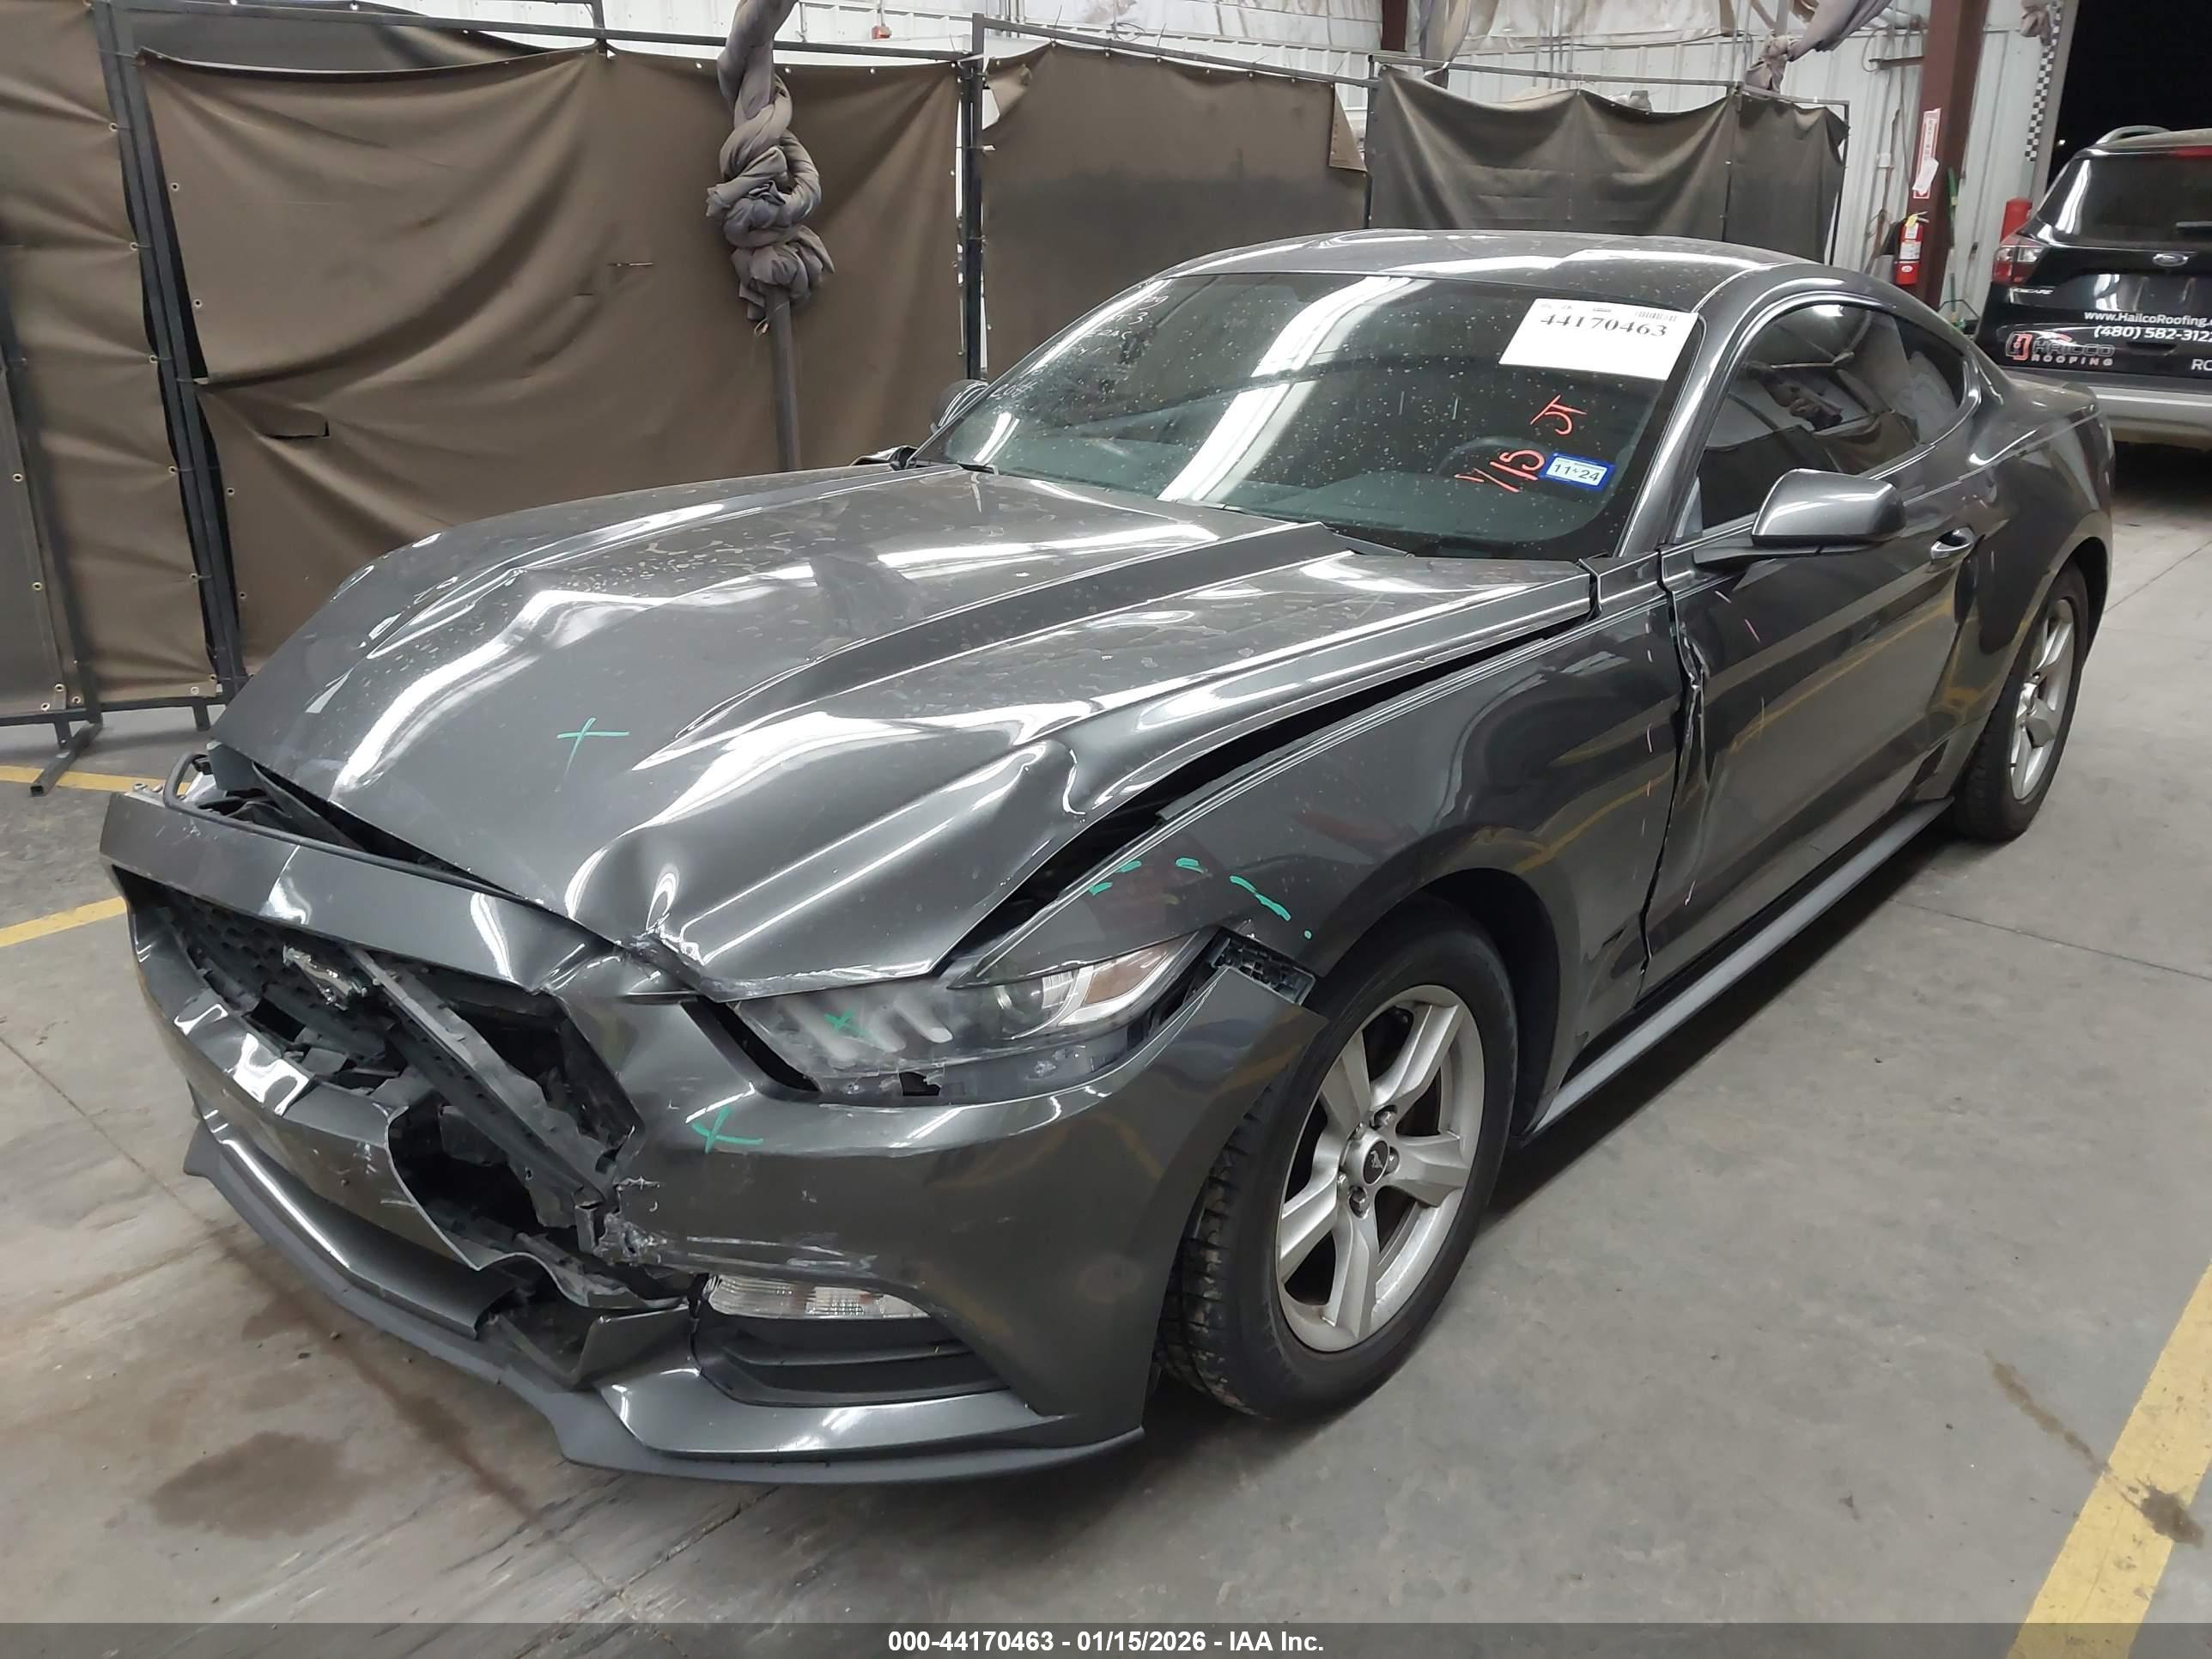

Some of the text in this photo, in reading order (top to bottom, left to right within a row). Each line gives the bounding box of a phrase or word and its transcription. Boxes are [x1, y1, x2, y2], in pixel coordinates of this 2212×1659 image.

[1540, 313, 1668, 337] 44170463
[2094, 325, 2142, 340] (480)
[2031, 354, 2114, 366] ROOFING
